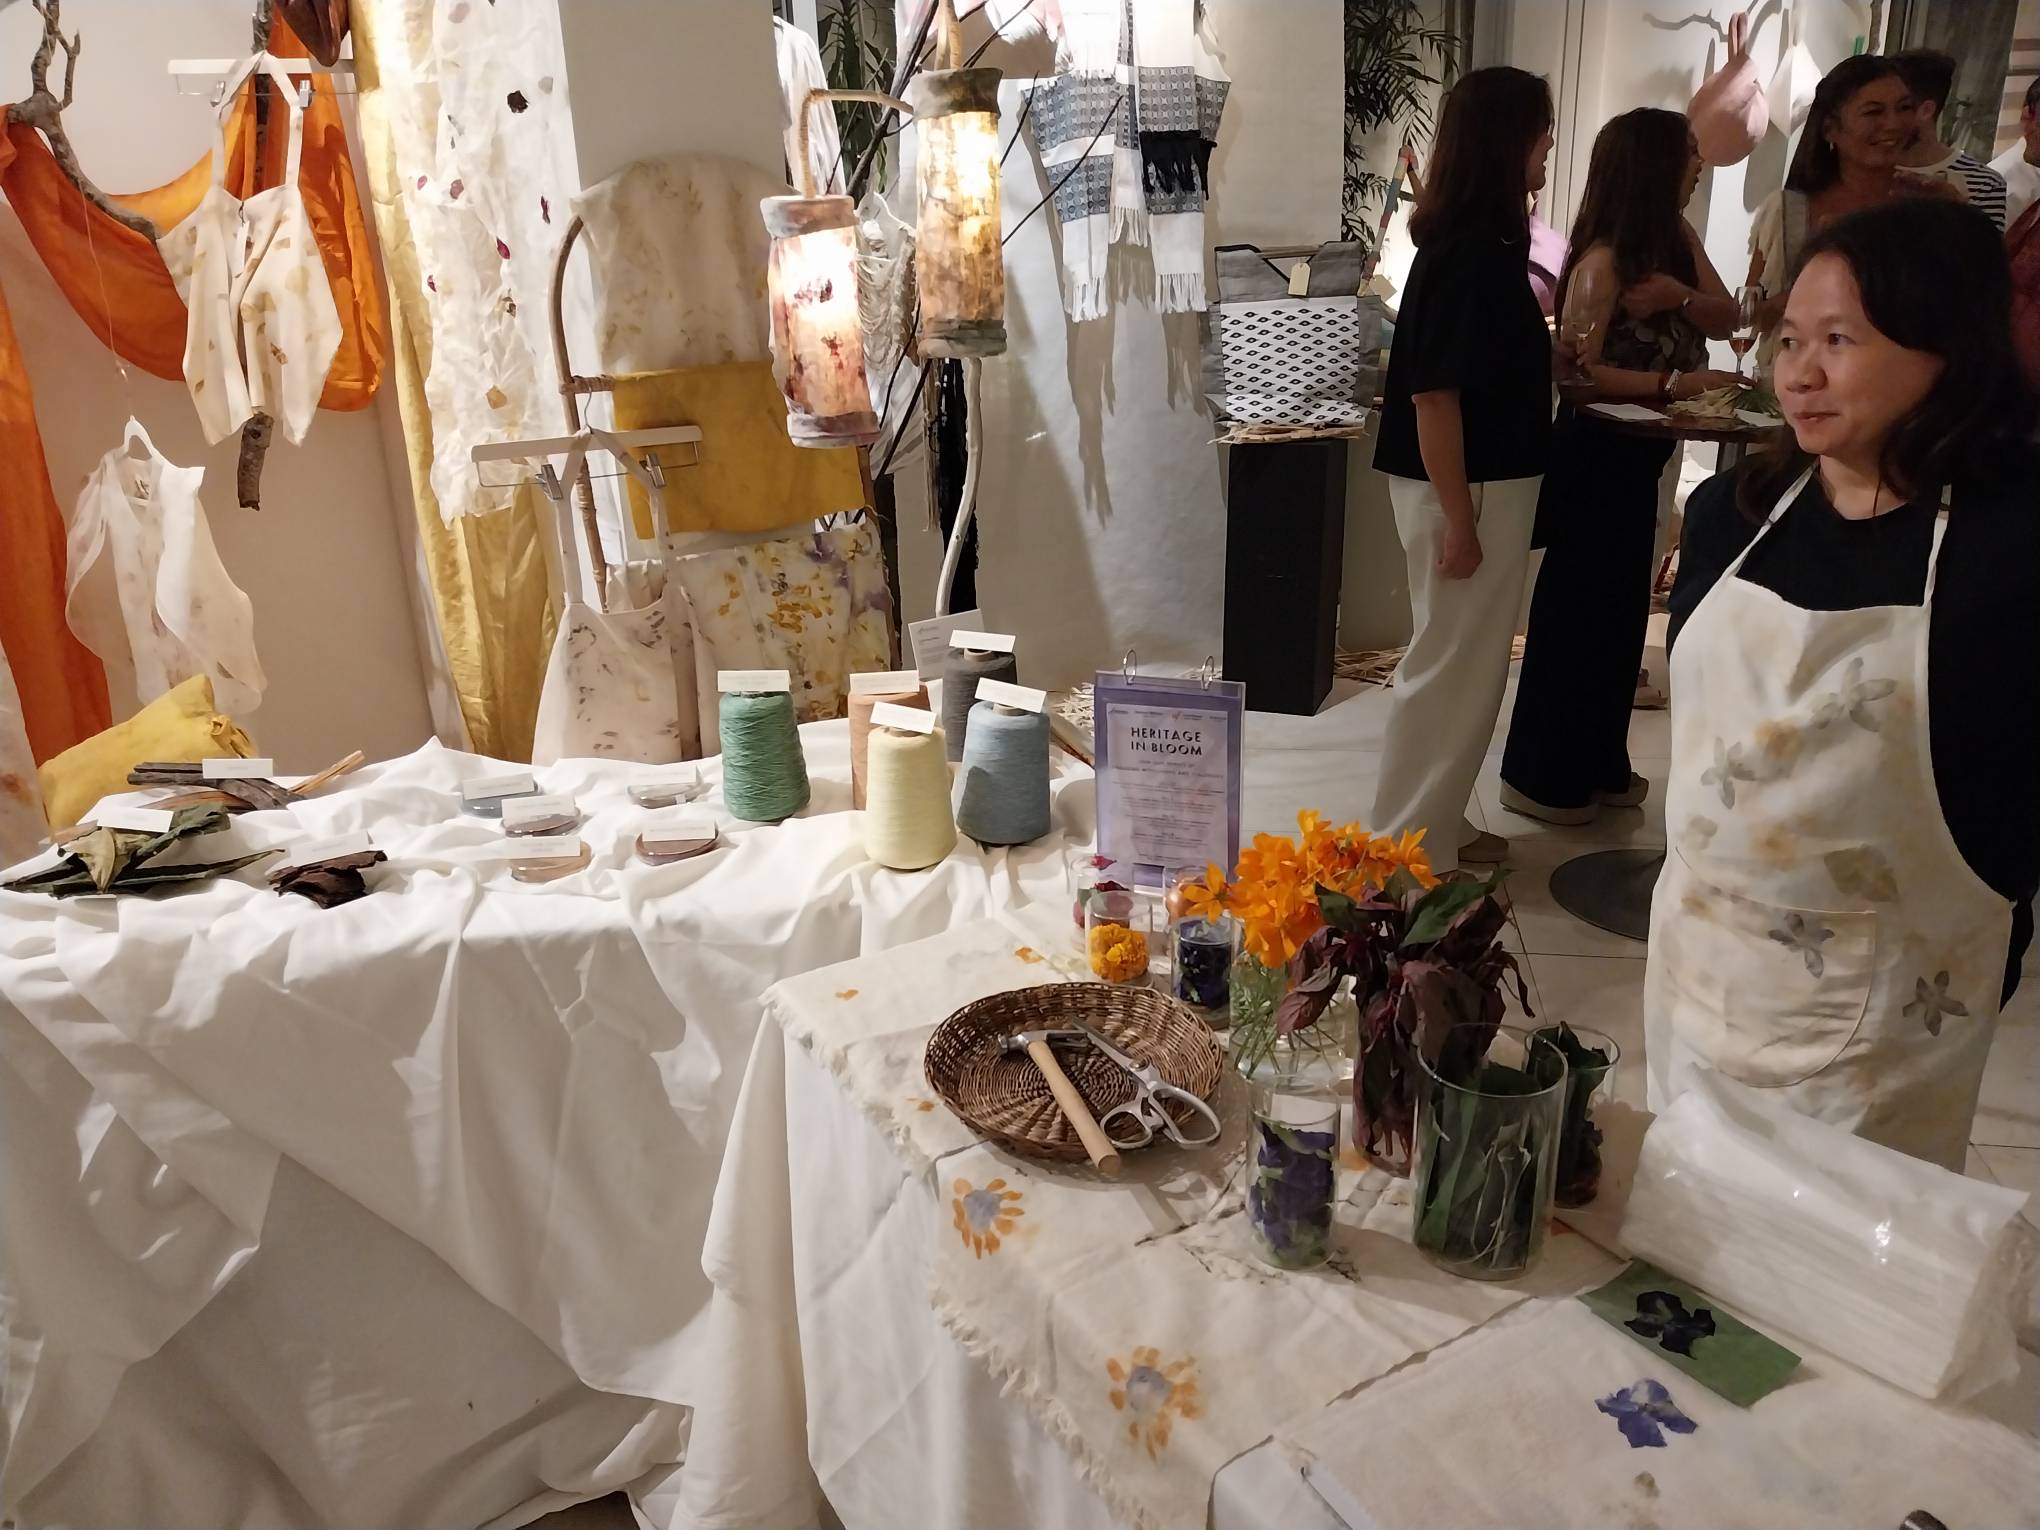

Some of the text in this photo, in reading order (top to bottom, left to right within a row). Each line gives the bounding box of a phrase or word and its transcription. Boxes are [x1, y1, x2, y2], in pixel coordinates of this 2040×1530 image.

[1131, 727, 1202, 742] HERITAGE
[1131, 741, 1202, 755] IN BLOOM
